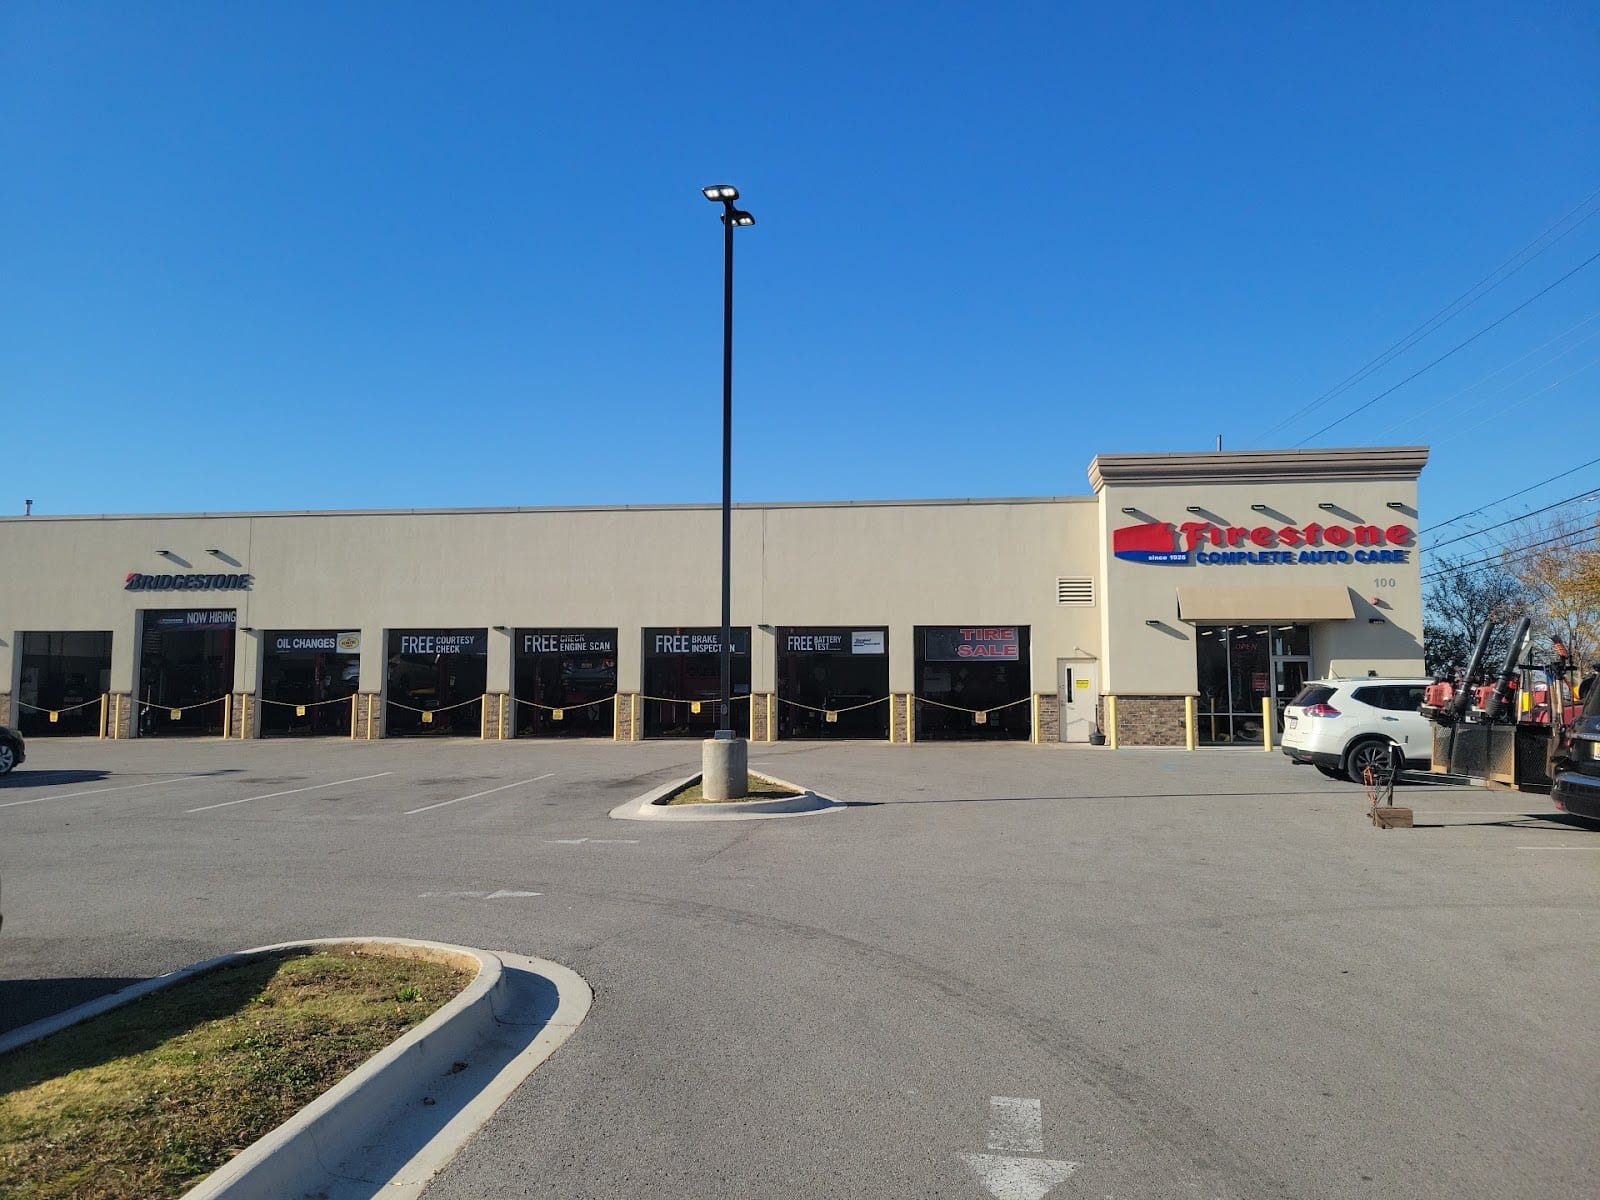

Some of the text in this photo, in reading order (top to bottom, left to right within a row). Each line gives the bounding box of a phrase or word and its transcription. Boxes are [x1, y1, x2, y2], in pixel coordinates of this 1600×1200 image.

[1180, 522, 1410, 552] Firestone
[1196, 550, 1405, 565] COMPLETE AUTO CARE
[125, 573, 250, 590] BRIDGESTONE
[1374, 578, 1396, 588] 100
[187, 612, 207, 624] NOW
[209, 610, 237, 623] HIRING
[560, 634, 585, 642] CHECK
[691, 635, 717, 644] BRAKE
[814, 635, 842, 644] BATTERY
[959, 628, 1015, 640] TIRE
[277, 639, 290, 649] OIL
[293, 638, 335, 649] CHANGES
[401, 636, 434, 654] FREE
[436, 636, 474, 645] COURTESY
[524, 635, 558, 652] FREE
[655, 635, 690, 653] FREE
[788, 636, 813, 651] FREE
[436, 645, 460, 654] CHECK
[560, 641, 610, 652] ENGINE SCAN
[691, 643, 735, 653] INSPECTN
[814, 643, 829, 651] TEST
[957, 644, 1018, 656] SALE
